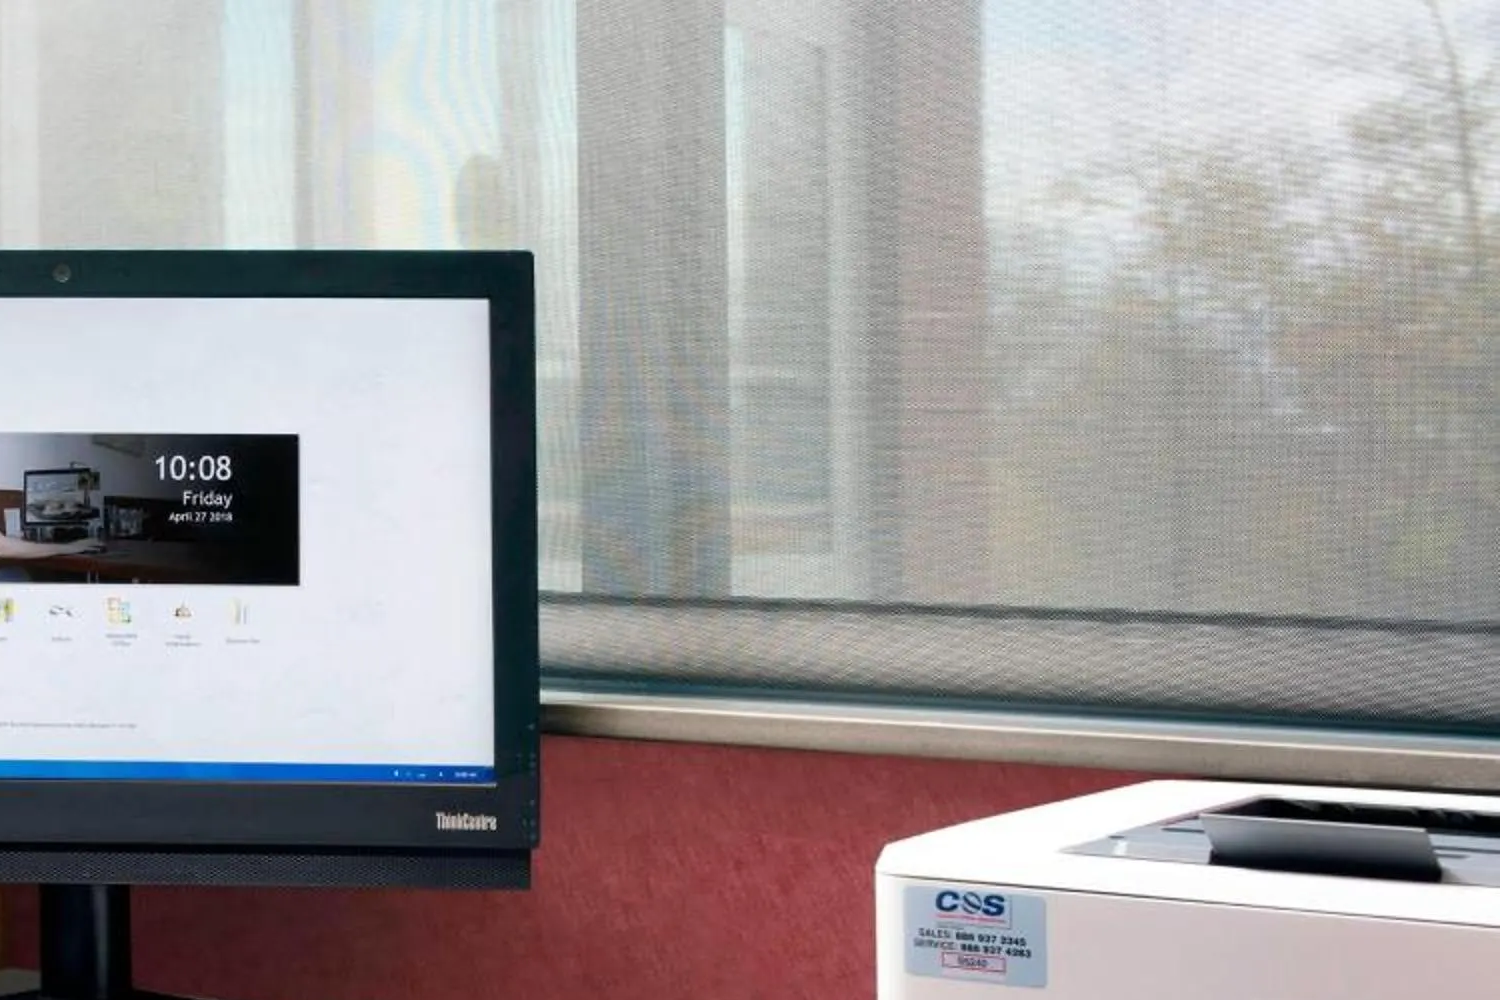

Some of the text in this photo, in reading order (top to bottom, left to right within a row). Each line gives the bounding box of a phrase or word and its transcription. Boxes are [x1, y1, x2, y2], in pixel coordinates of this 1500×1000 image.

[155, 454, 232, 481] 10:08
[183, 490, 233, 509] Friday
[168, 511, 193, 524] April
[195, 511, 207, 522] 27
